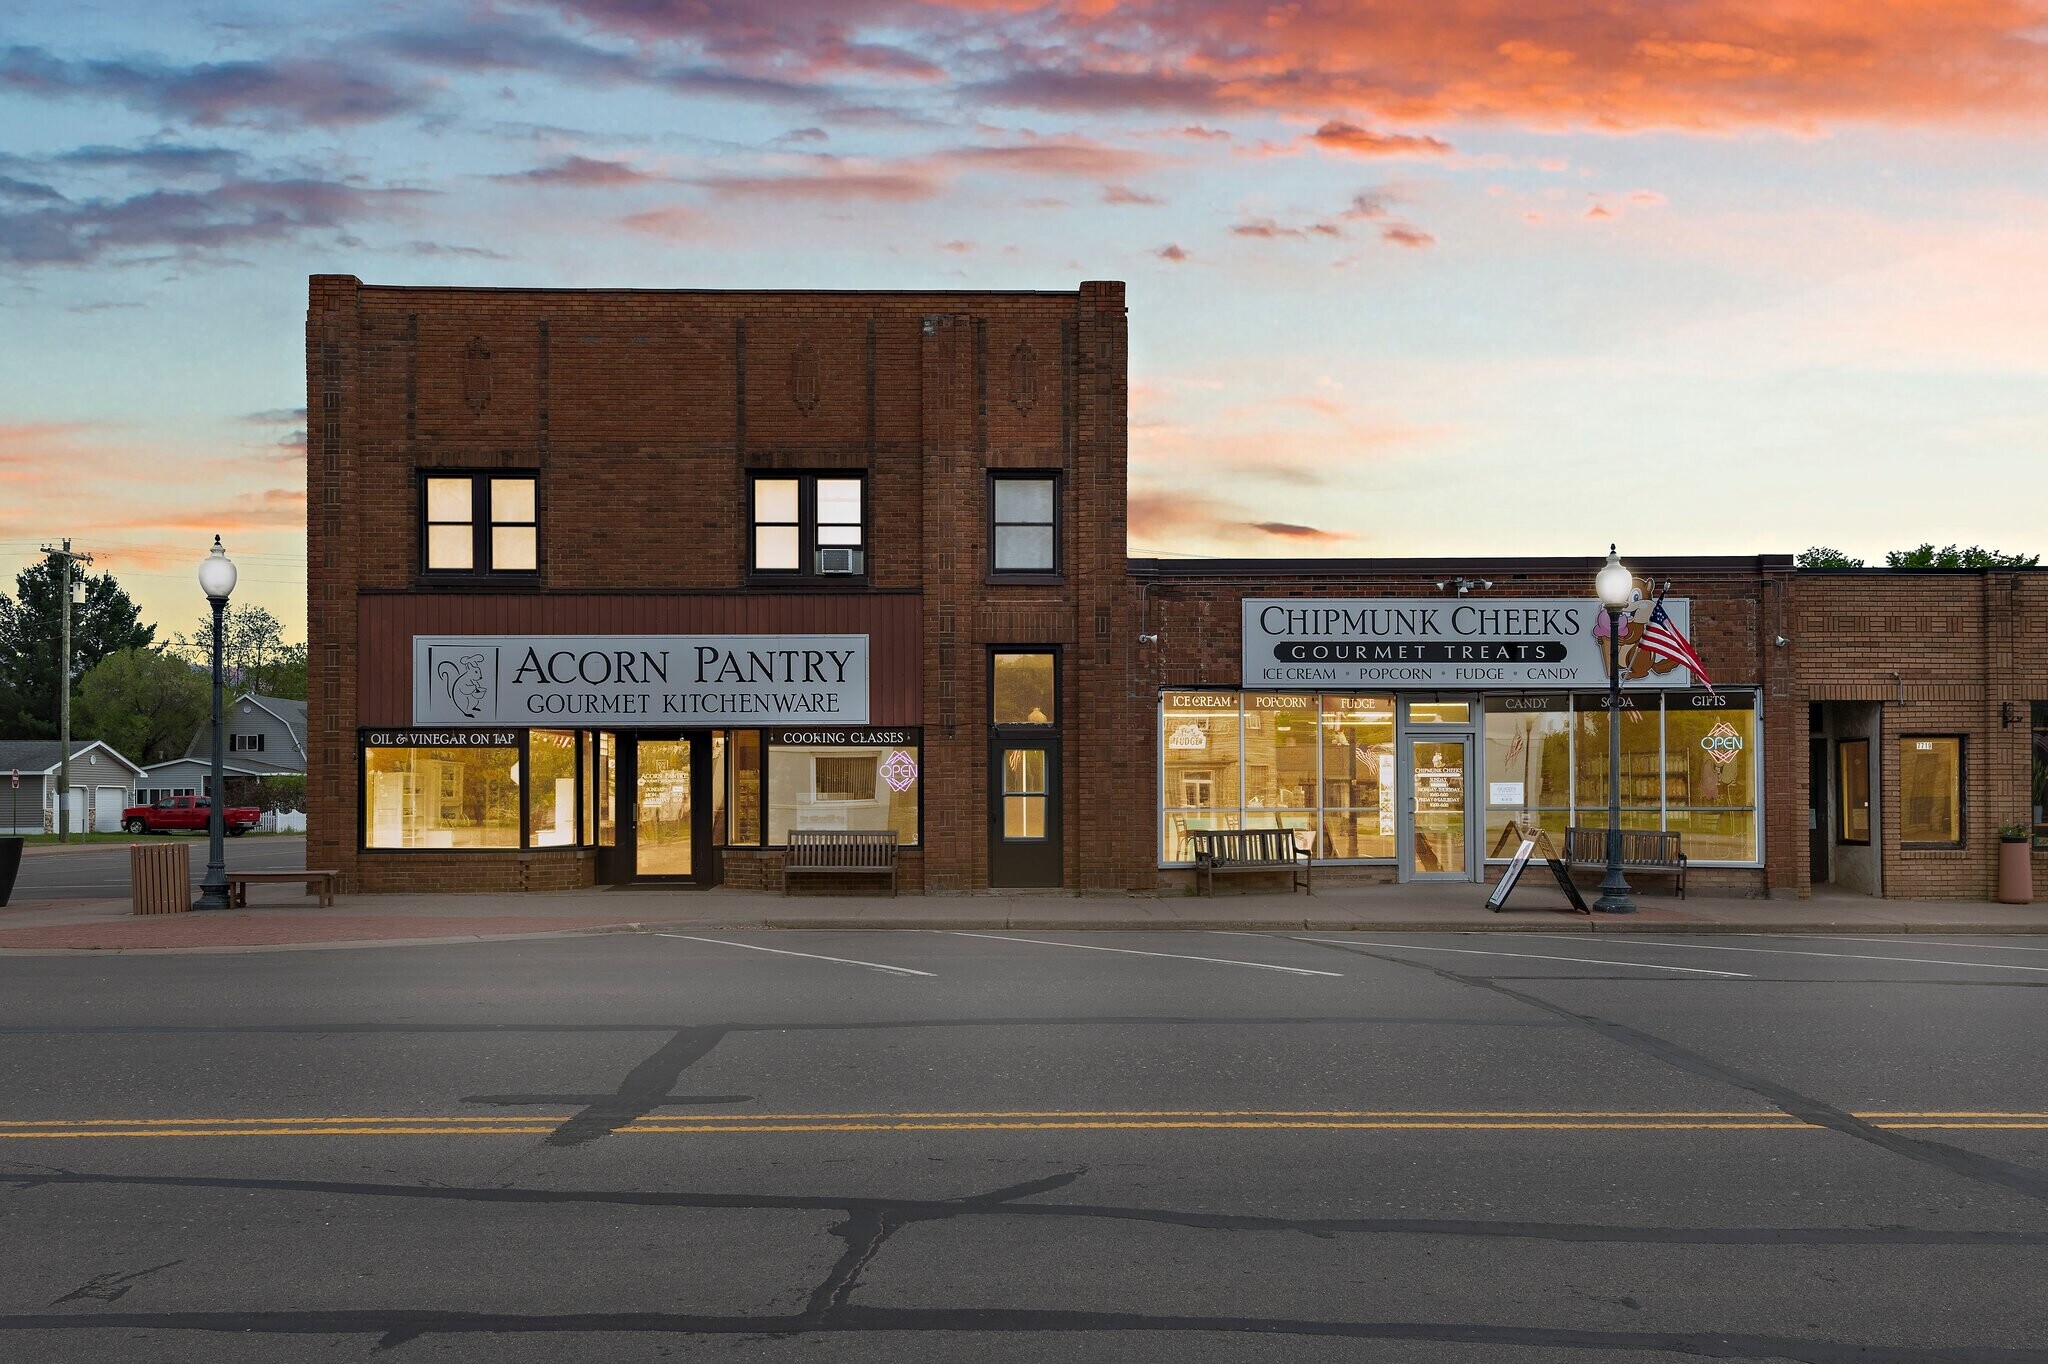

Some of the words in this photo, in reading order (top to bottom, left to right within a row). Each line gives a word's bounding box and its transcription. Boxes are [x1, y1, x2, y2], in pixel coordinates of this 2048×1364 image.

[1260, 605, 1442, 636] CHIPMUNK
[1451, 605, 1580, 636] CHEEKS
[1291, 645, 1426, 659] GOURMET
[1444, 645, 1546, 659] TREATS
[511, 646, 670, 686] ACORN
[693, 646, 856, 684] PANTRY
[1263, 668, 1283, 680] ICE
[1286, 668, 1337, 680] CREAM
[1360, 668, 1432, 680] POPCORN
[1456, 668, 1505, 680] FUDGE
[1527, 668, 1579, 680] CANDY
[526, 693, 650, 714] GOURMET
[663, 693, 840, 713] KITCHENWARE
[1172, 695, 1191, 707] ICE
[1192, 695, 1231, 707] CREAM
[1256, 696, 1307, 708] POPCORN
[1341, 698, 1376, 709] FUDGE
[1505, 698, 1550, 709] CANDY
[1692, 695, 1726, 706] GIFTS
[370, 733, 393, 745] OIL
[396, 733, 408, 745] &
[409, 733, 467, 745] VINEGAR
[470, 733, 490, 745] ON
[493, 733, 515, 744] TAP
[783, 732, 845, 743] COOKING
[850, 732, 904, 743] CLASSES
[1700, 736, 1743, 750] OPEN
[879, 764, 918, 778] OPEN
